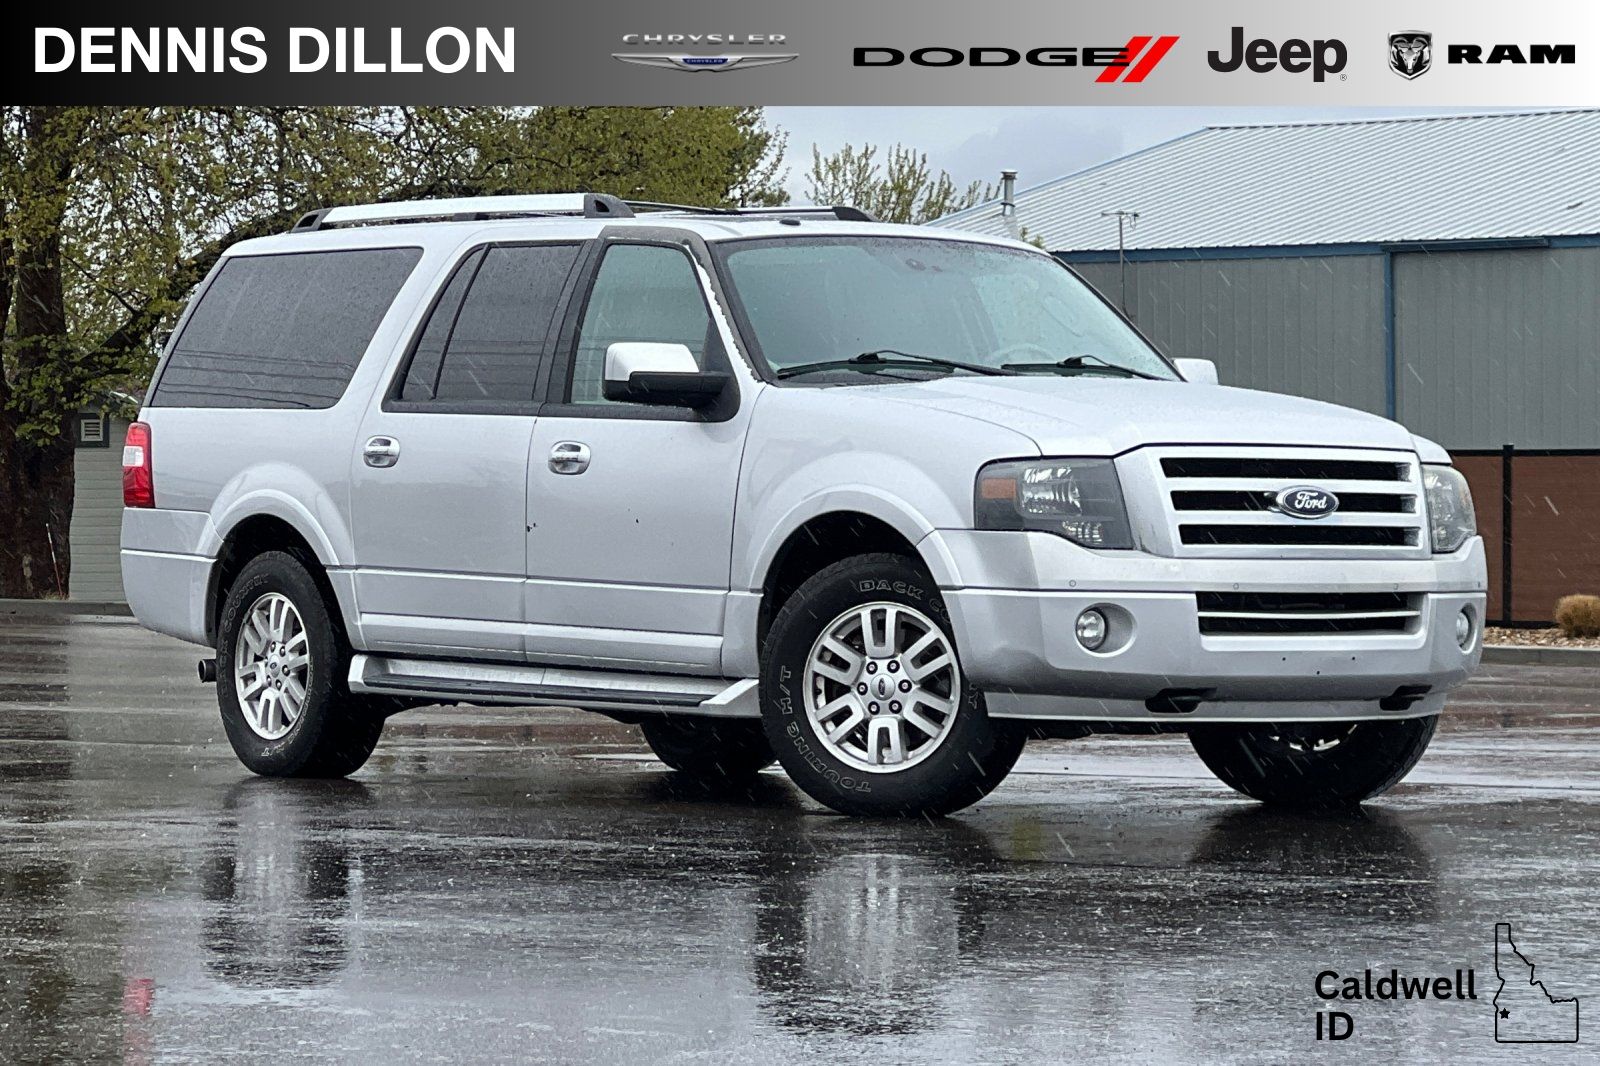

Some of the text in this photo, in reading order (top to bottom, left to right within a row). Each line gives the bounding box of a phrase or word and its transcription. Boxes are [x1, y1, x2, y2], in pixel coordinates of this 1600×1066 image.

[1294, 491, 1328, 509] Ford
[859, 580, 923, 601] BACK
[786, 721, 872, 792] TOURING
